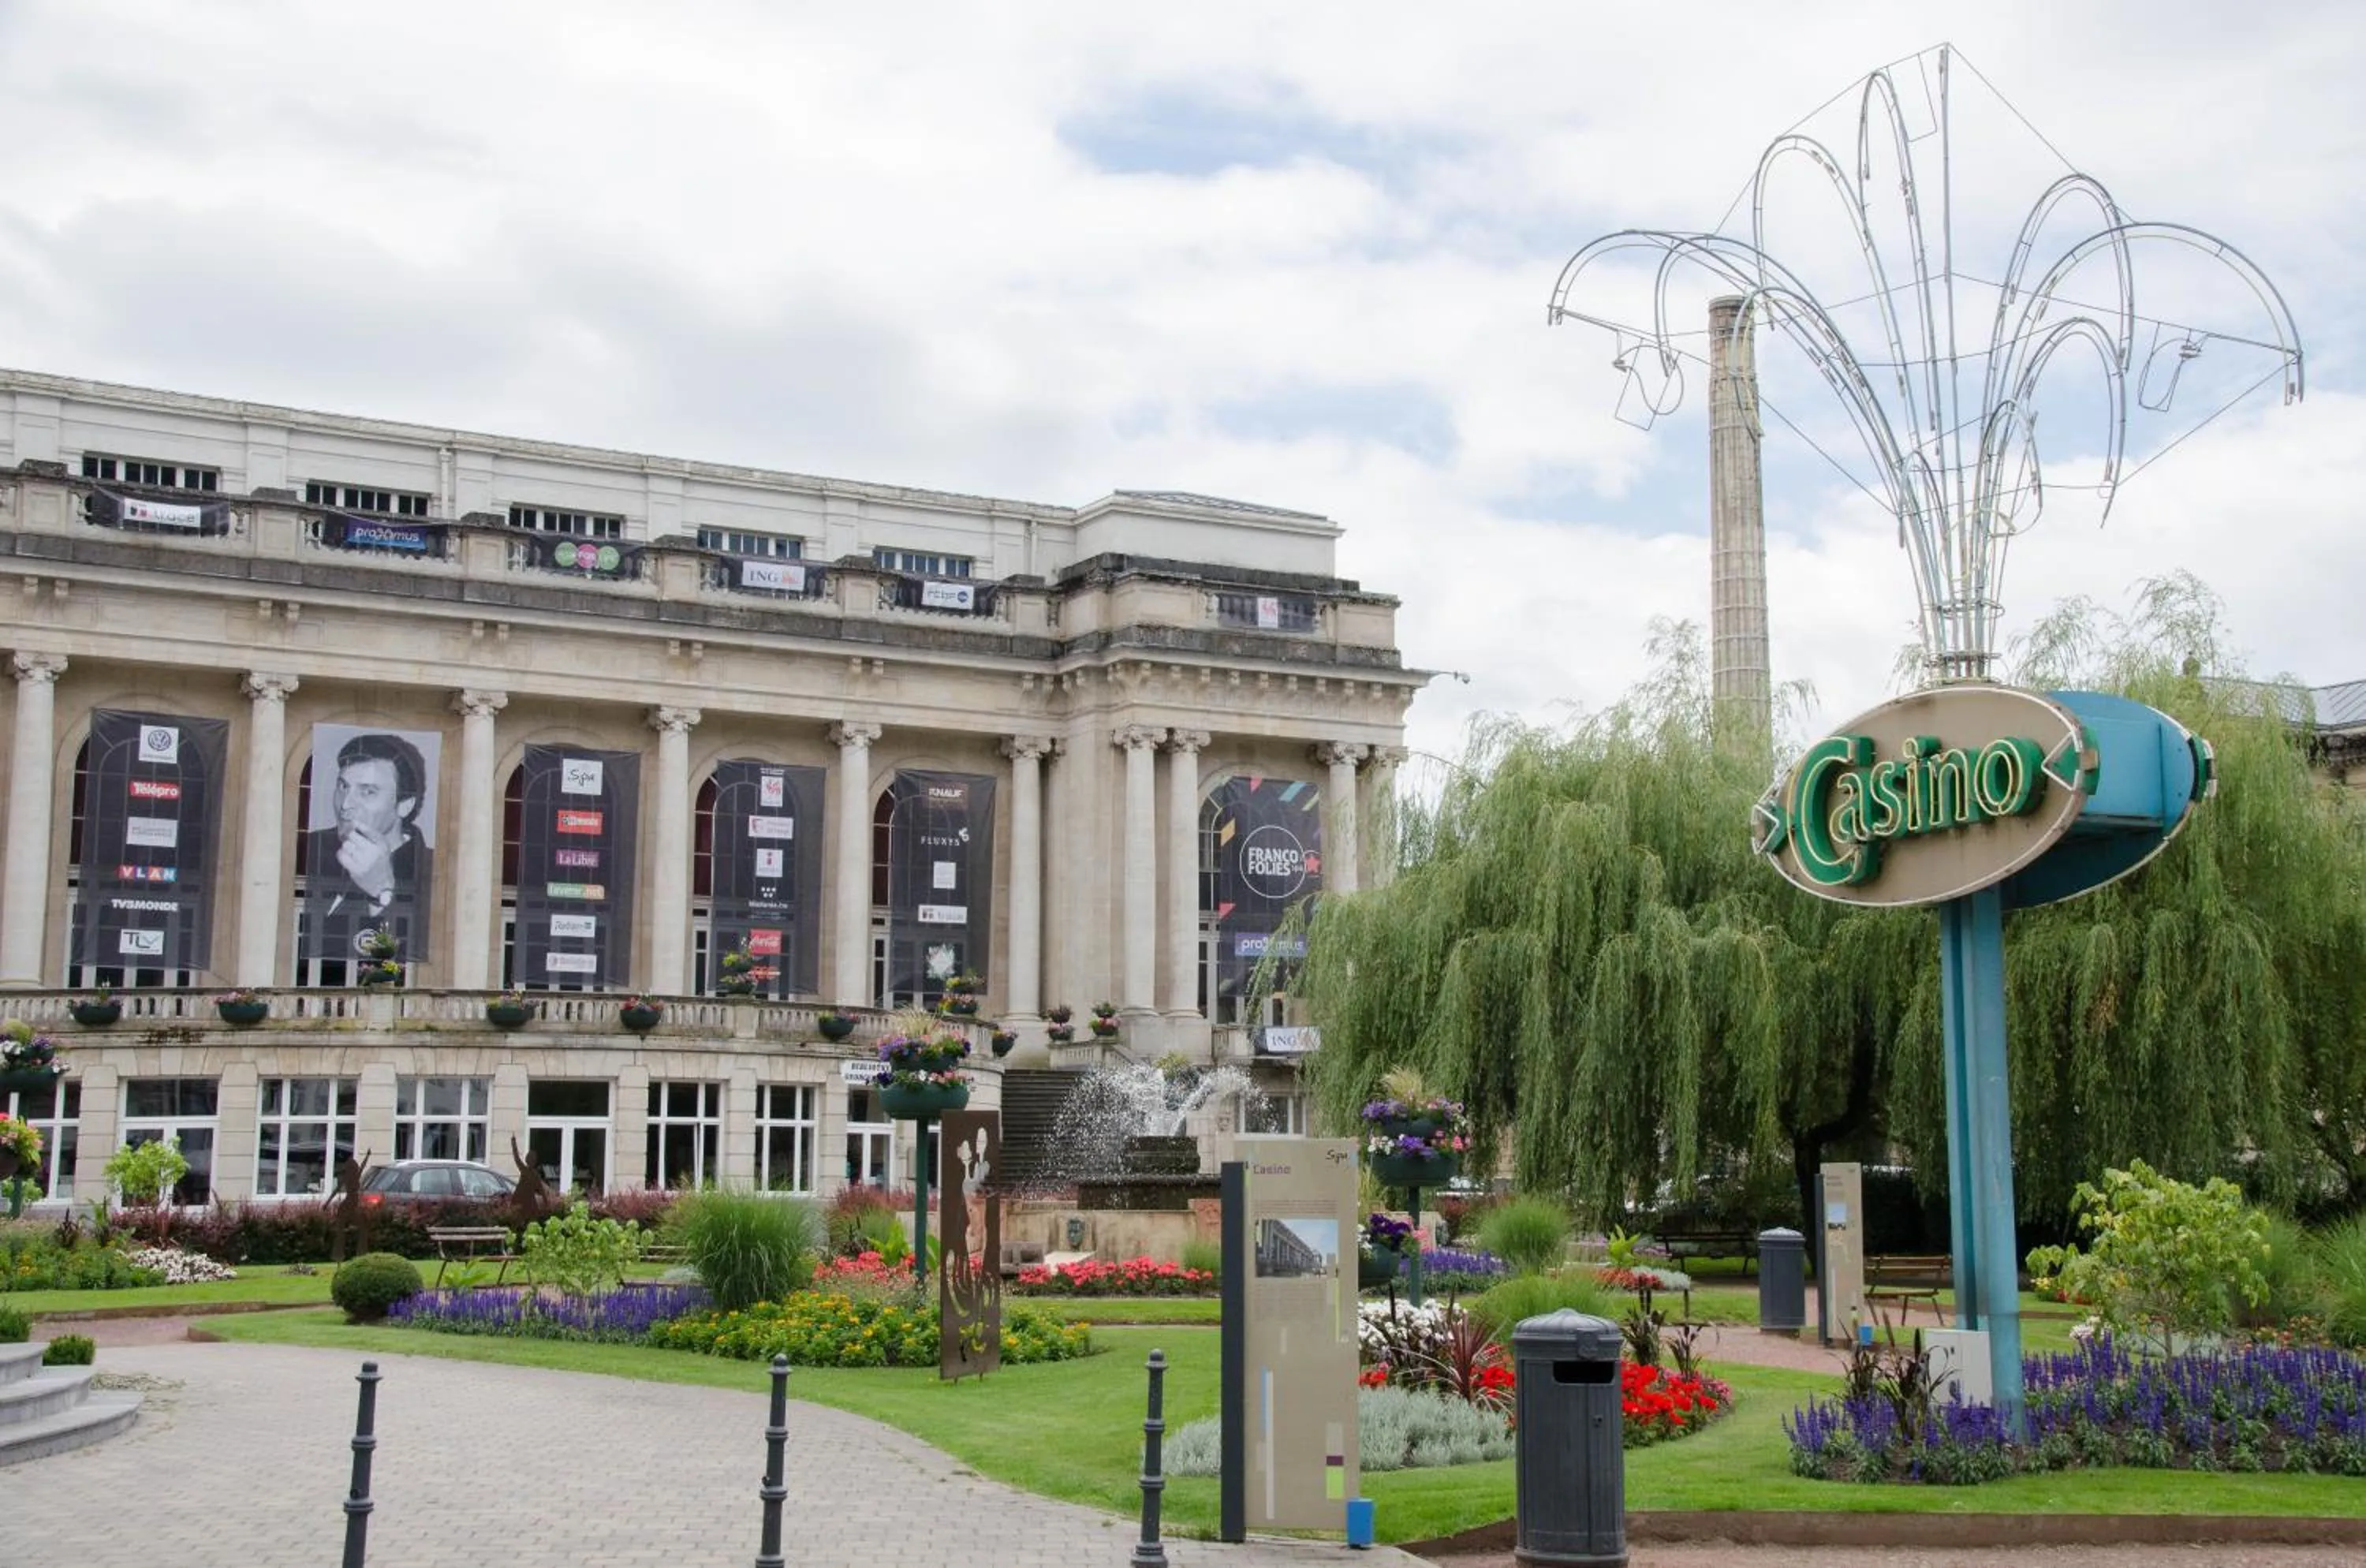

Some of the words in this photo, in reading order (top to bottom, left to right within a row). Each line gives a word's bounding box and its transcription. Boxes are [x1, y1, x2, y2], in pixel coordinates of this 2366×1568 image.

[750, 569, 780, 582] ING
[1787, 736, 2044, 886] Casino
[558, 853, 572, 866] La
[1248, 847, 1299, 864] FRANCO
[122, 866, 175, 879] VLAN
[1248, 861, 1291, 876] FOLIES
[111, 898, 178, 912] TV5MONDE
[1252, 1165, 1291, 1174] Casino
